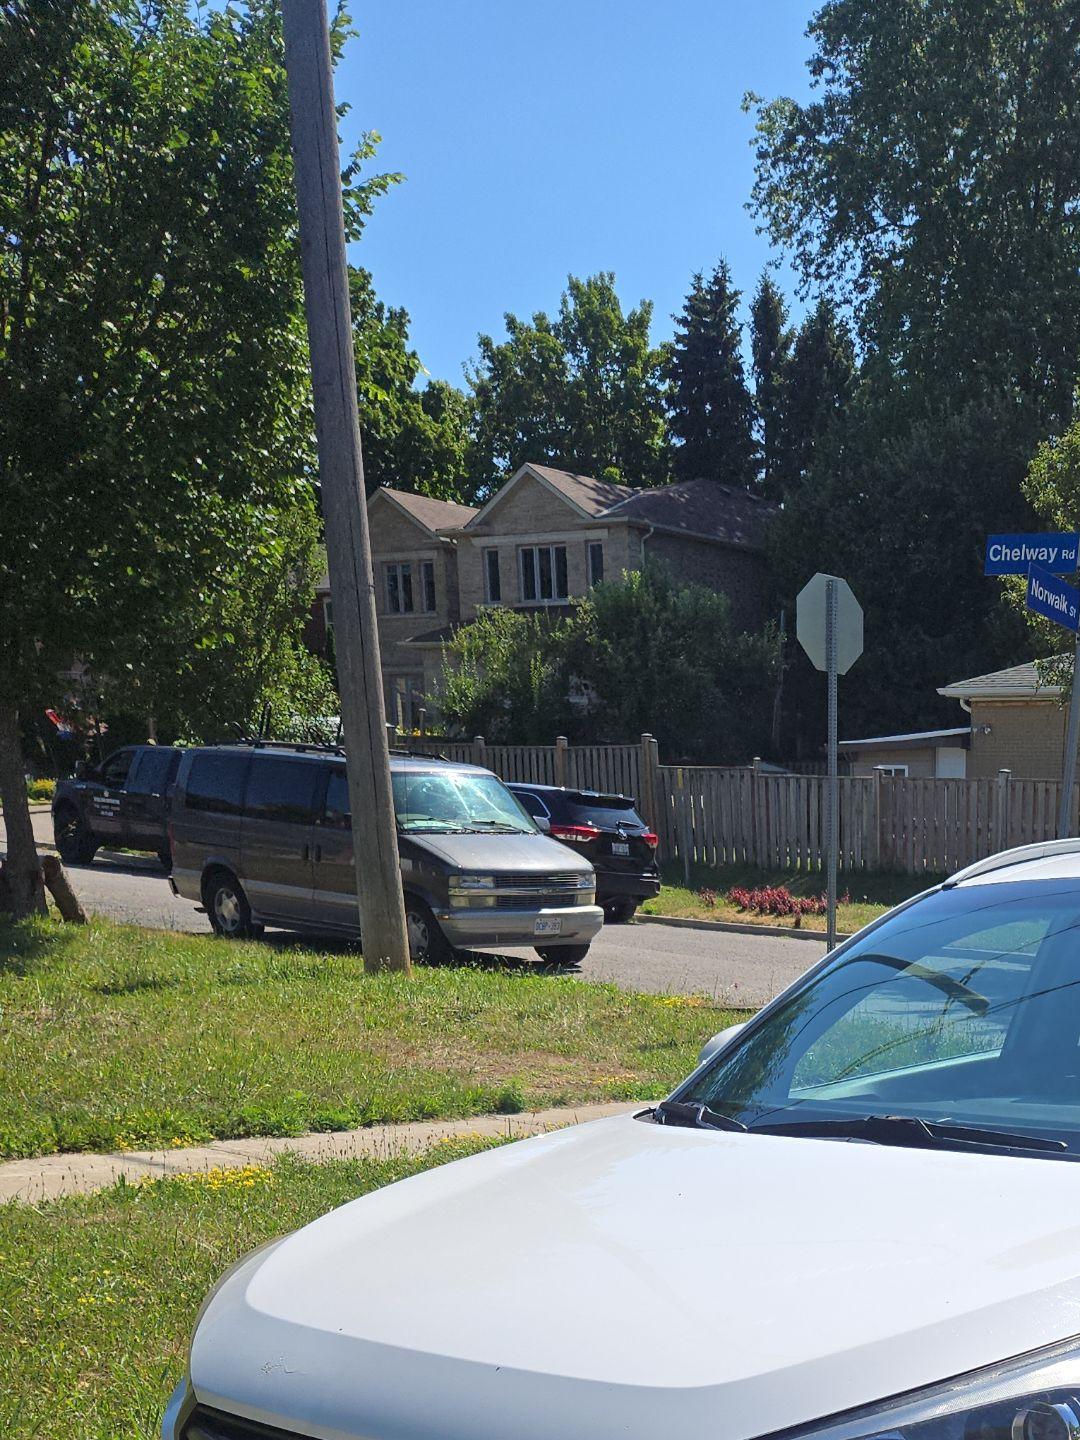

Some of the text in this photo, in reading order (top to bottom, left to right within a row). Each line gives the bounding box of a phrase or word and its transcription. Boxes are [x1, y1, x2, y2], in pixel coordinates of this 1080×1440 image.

[989, 543, 1076, 564] Chelway Rd
[1030, 578, 1077, 618] Norwalk St
